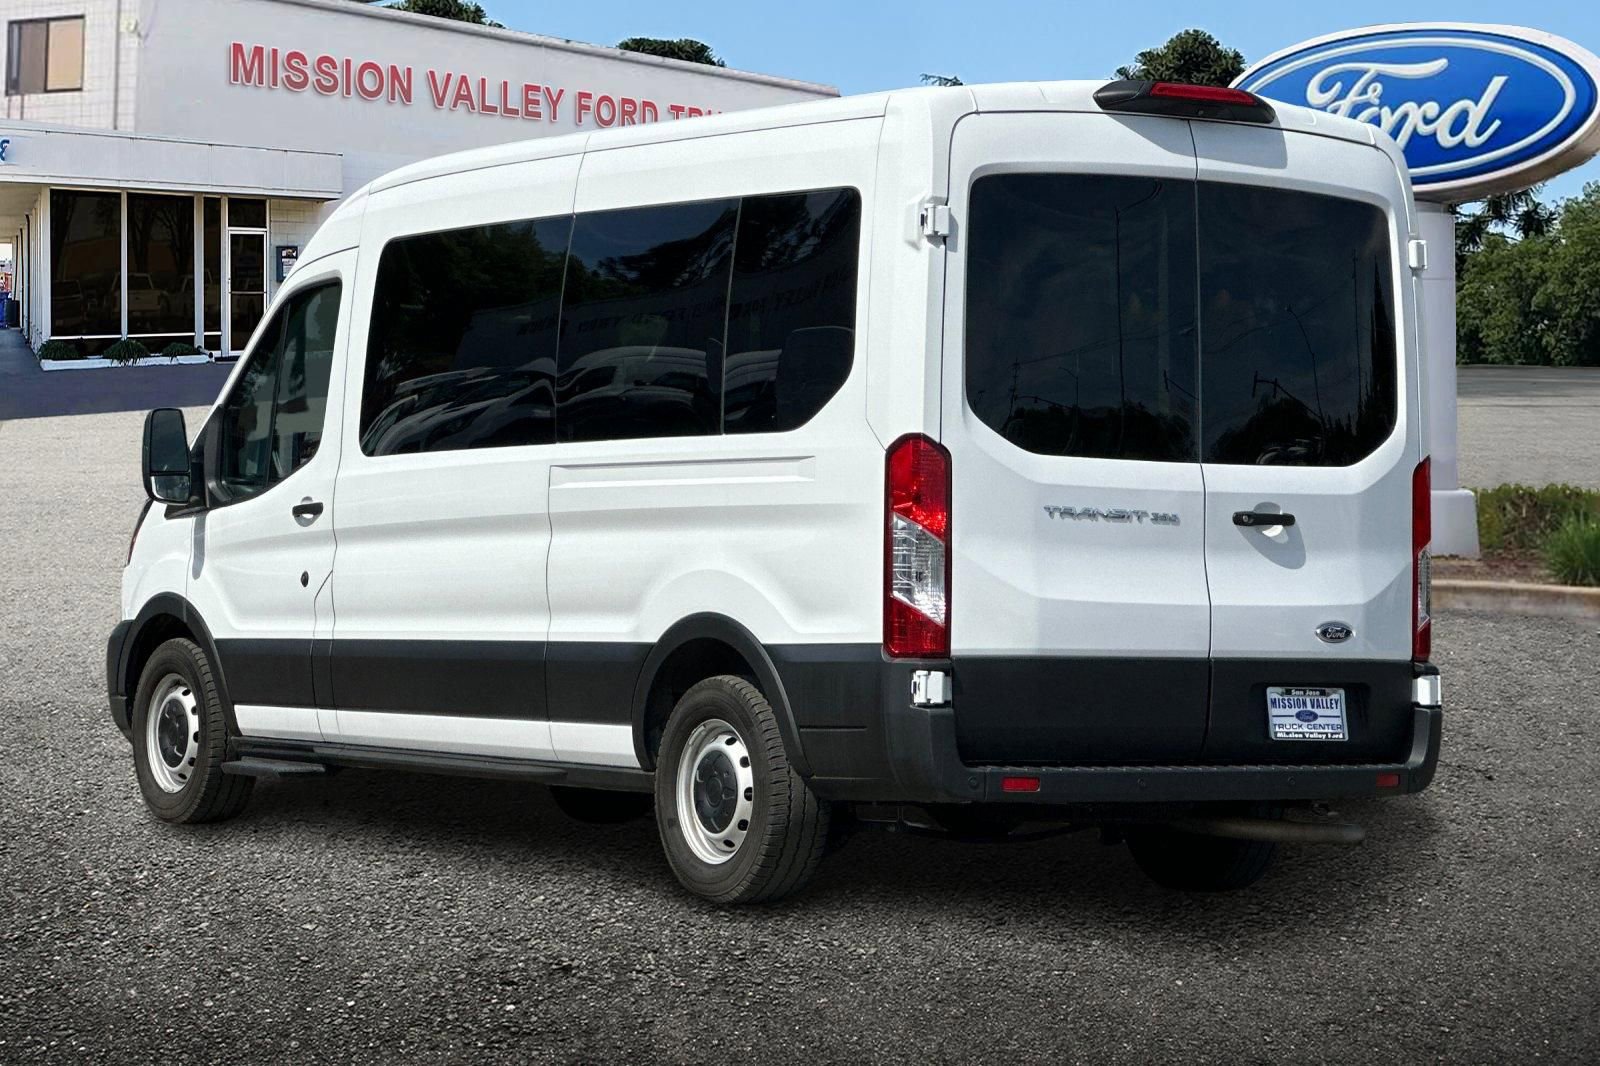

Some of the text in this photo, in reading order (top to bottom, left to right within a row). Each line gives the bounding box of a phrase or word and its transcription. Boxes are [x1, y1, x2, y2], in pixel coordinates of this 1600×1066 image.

[231, 42, 659, 127] MISSION VALLEY FORD
[1043, 505, 1149, 524] TRANSIT
[1326, 626, 1347, 638] Ford
[1271, 698, 1339, 709] MISSION VALLEY
[1273, 723, 1343, 731] TRUCK CENTER
